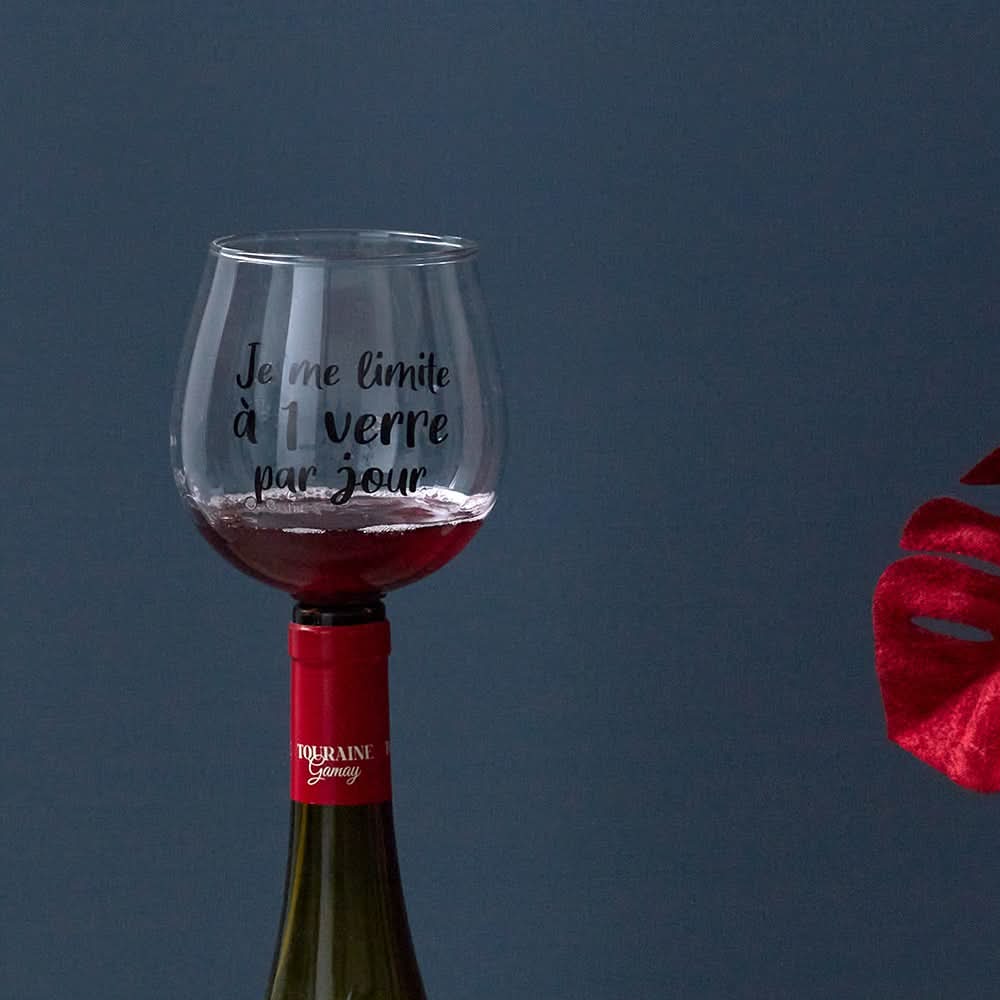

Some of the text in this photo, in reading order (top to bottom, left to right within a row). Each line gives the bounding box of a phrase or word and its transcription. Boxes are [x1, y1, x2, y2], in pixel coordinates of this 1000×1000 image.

[236, 342, 450, 393] Je me limite
[233, 398, 449, 450] à 1 verre
[255, 452, 426, 505] par jour
[297, 743, 374, 761] TOURAINE
[307, 754, 361, 785] Gamay
